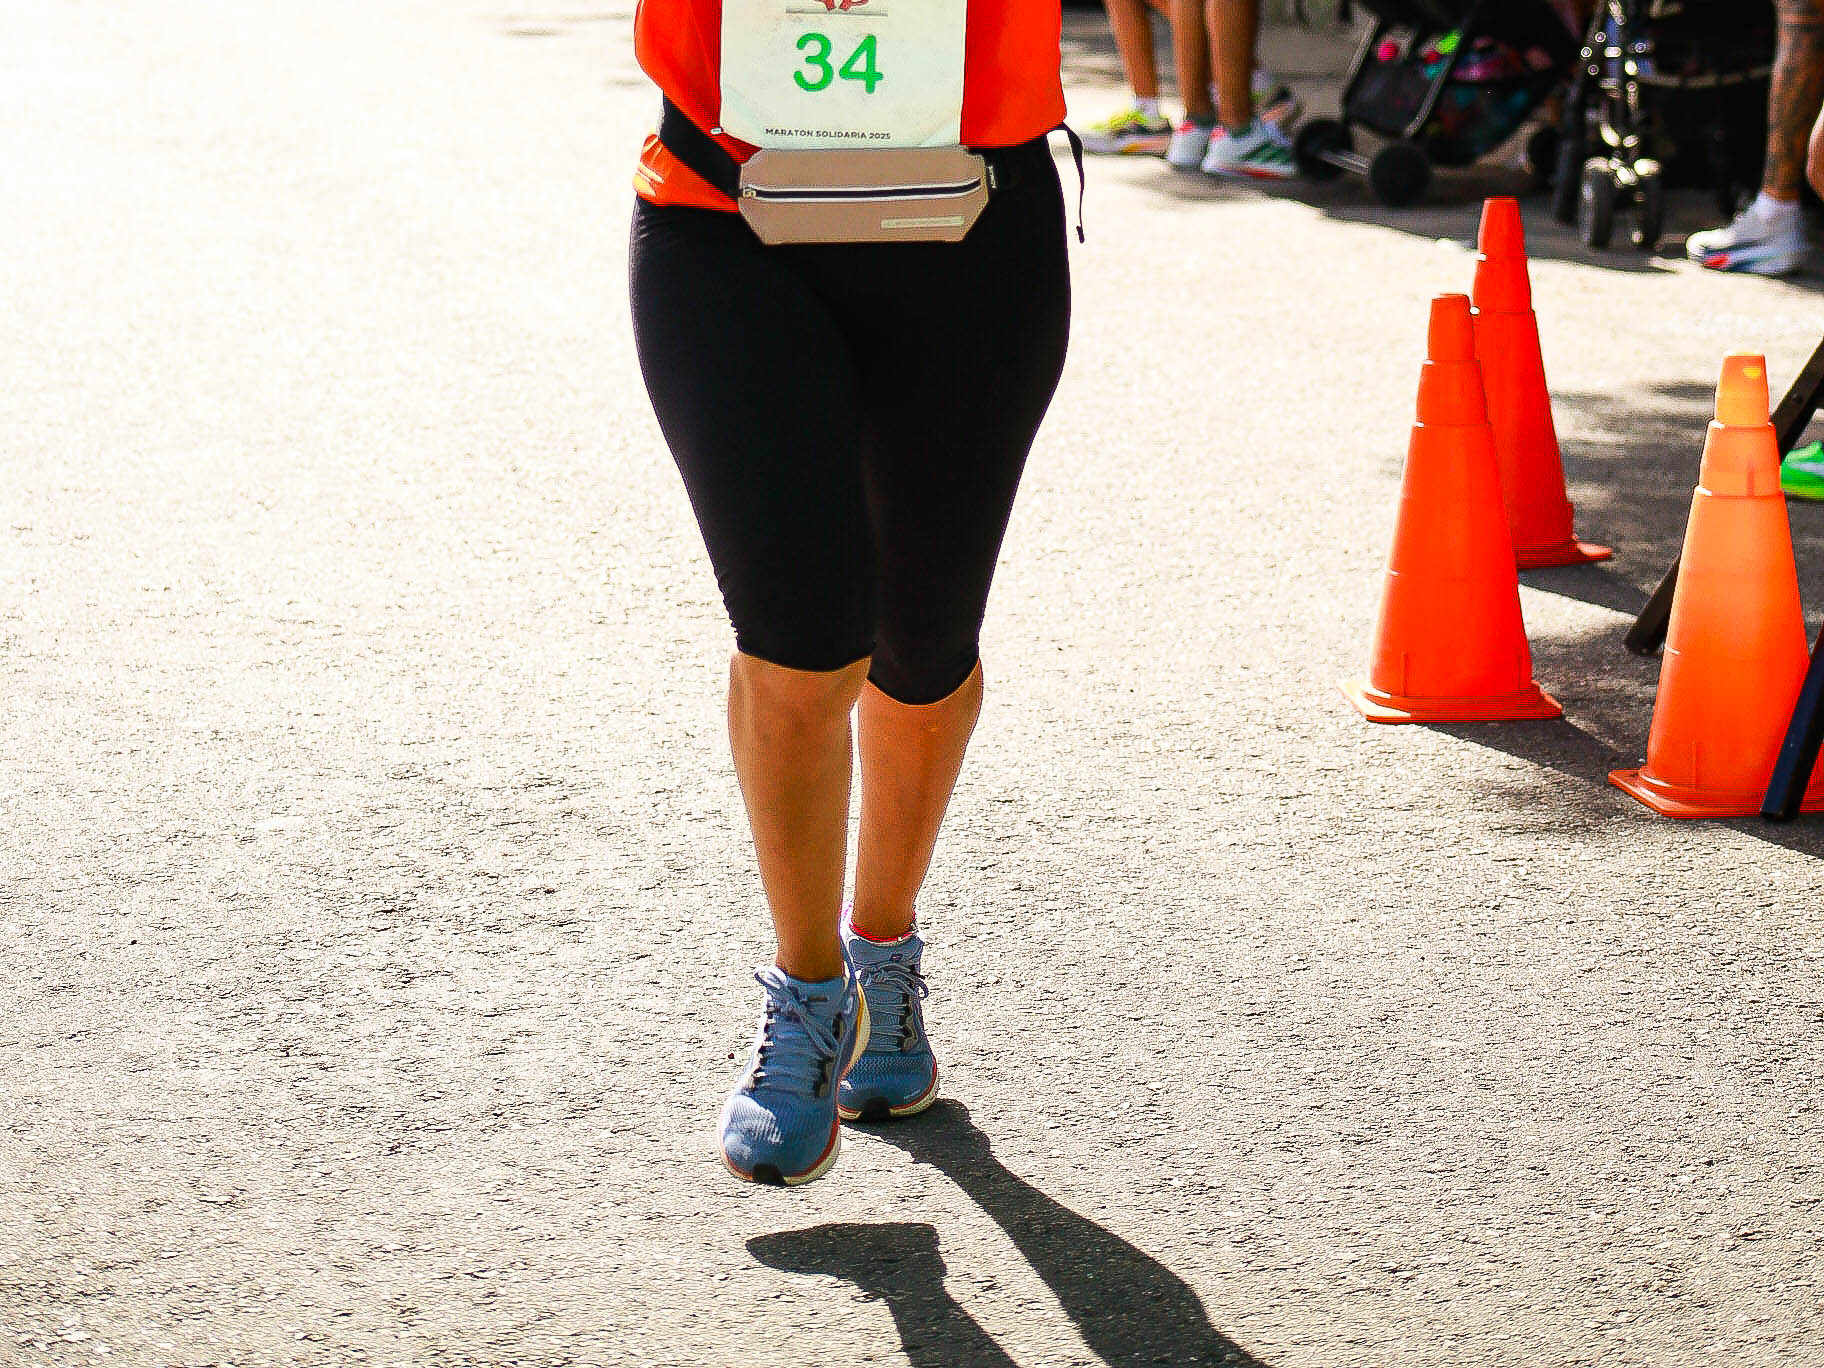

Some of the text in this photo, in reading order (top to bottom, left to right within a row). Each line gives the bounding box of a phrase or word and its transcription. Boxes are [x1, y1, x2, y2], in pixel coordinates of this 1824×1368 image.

[793, 32, 884, 94] 34
[765, 127, 891, 140] MARATON SOLIDARIA 2025
